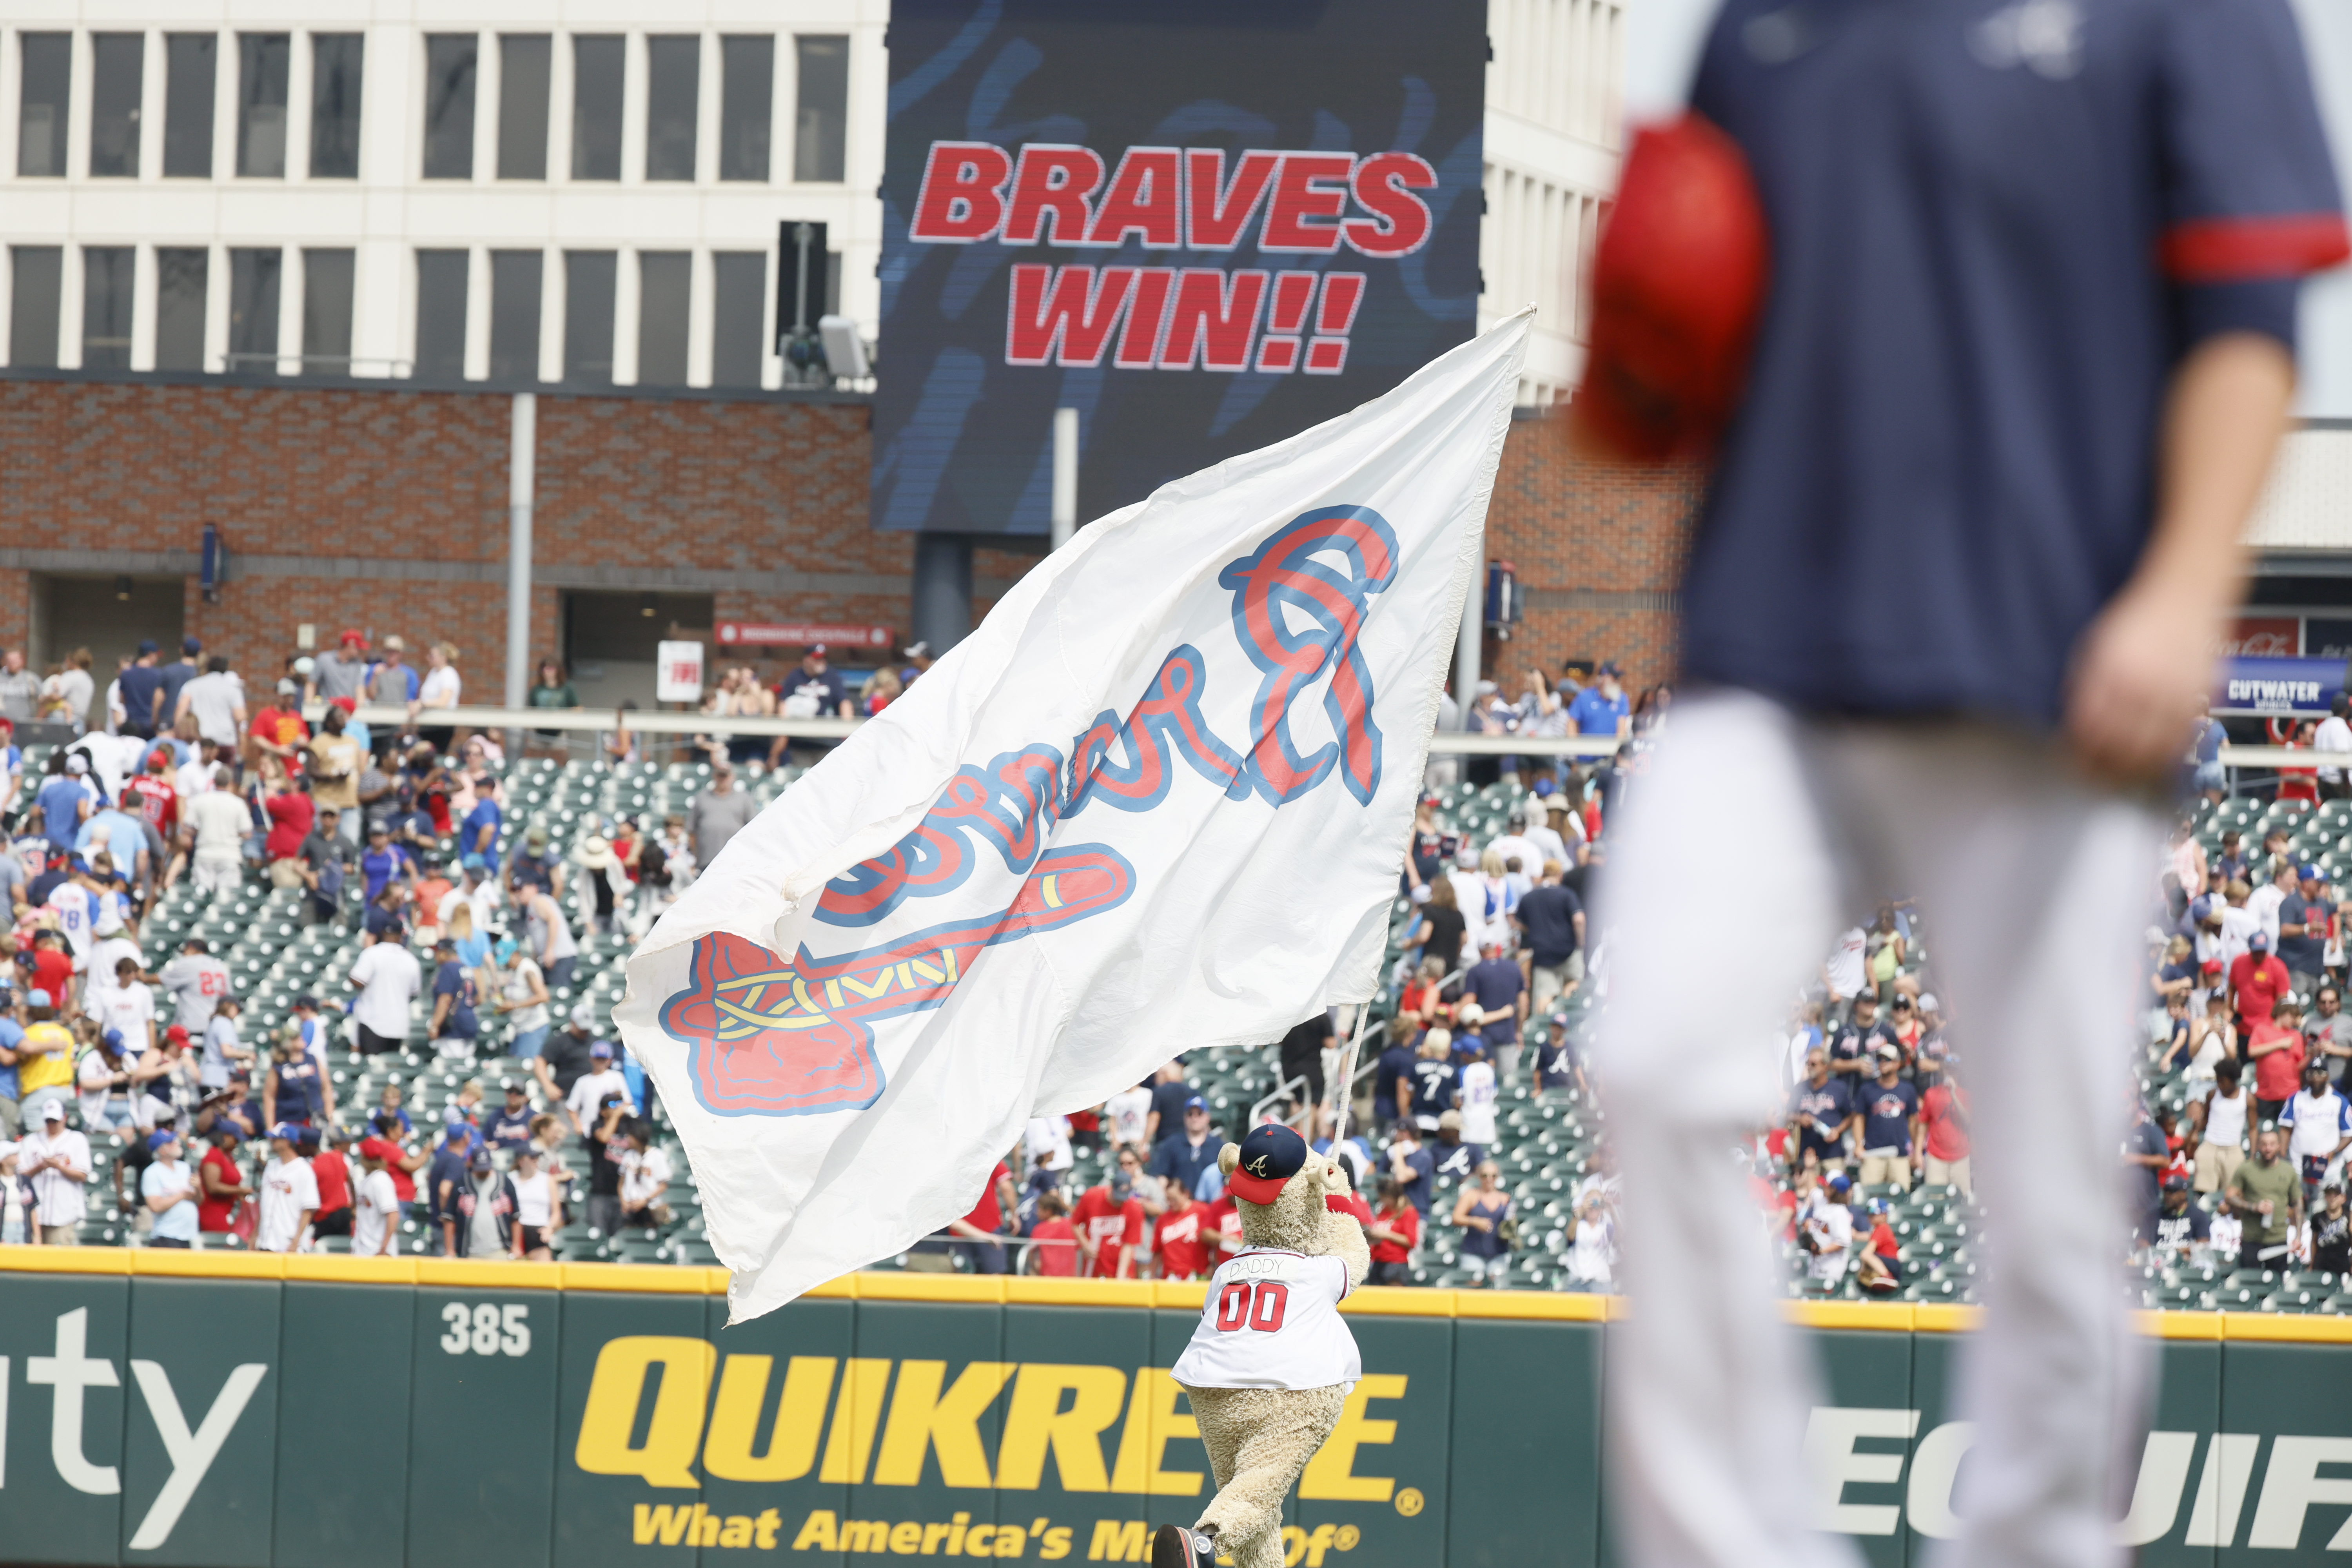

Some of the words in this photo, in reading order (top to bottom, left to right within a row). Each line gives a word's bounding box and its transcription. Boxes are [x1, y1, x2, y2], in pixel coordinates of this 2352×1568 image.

[909, 140, 1438, 258] BRAVES
[1005, 263, 1367, 375] WIN!!
[2228, 679, 2321, 702] CUTWATER
[1423, 1073, 1442, 1102] 7
[1245, 1154, 1268, 1178] A
[1230, 1258, 1285, 1278] DADDY
[441, 1303, 530, 1356] 385
[1216, 1281, 1289, 1333] 00
[575, 1335, 1409, 1502] QUIKREE
[633, 1503, 782, 1550] What
[792, 1510, 1073, 1560] America's
